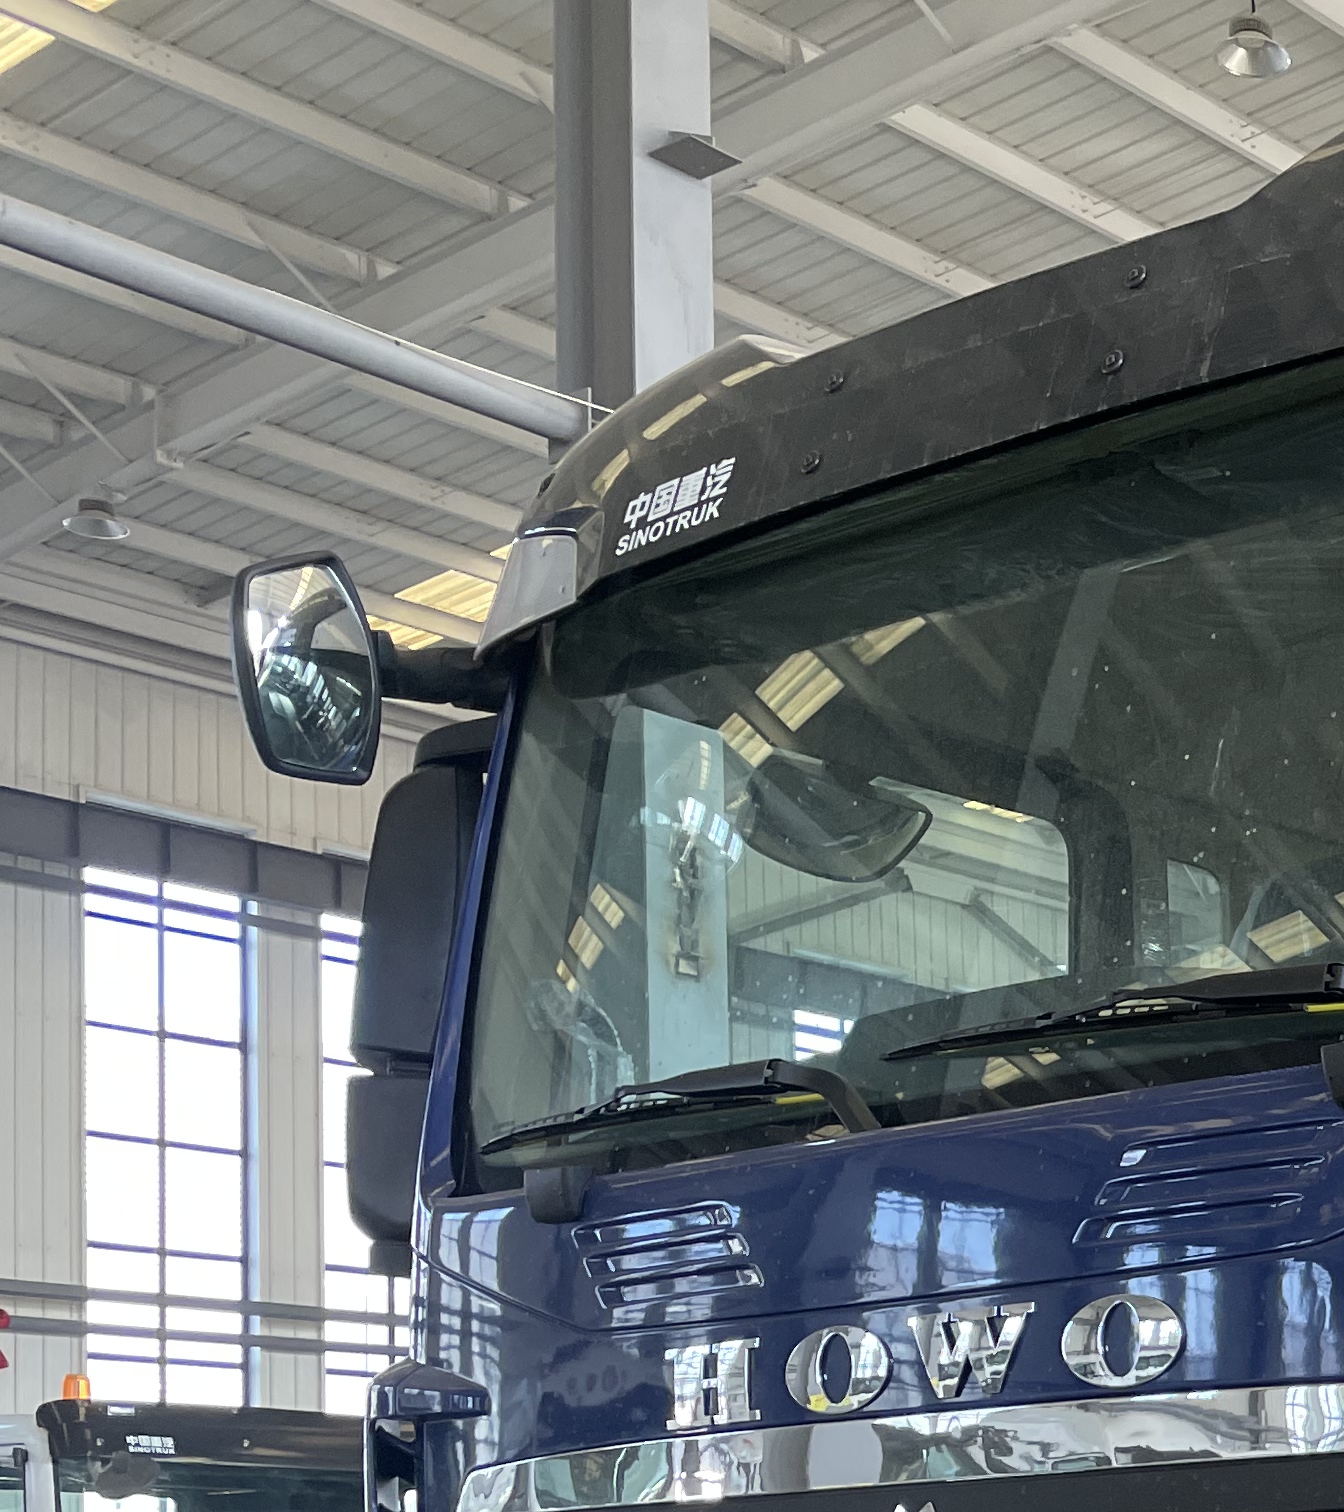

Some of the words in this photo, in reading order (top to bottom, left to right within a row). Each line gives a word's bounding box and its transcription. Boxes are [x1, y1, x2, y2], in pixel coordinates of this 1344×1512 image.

[615, 497, 724, 557] SINOTRUK
[623, 456, 737, 530] 中国重汽
[664, 1293, 1187, 1432] HOWO
